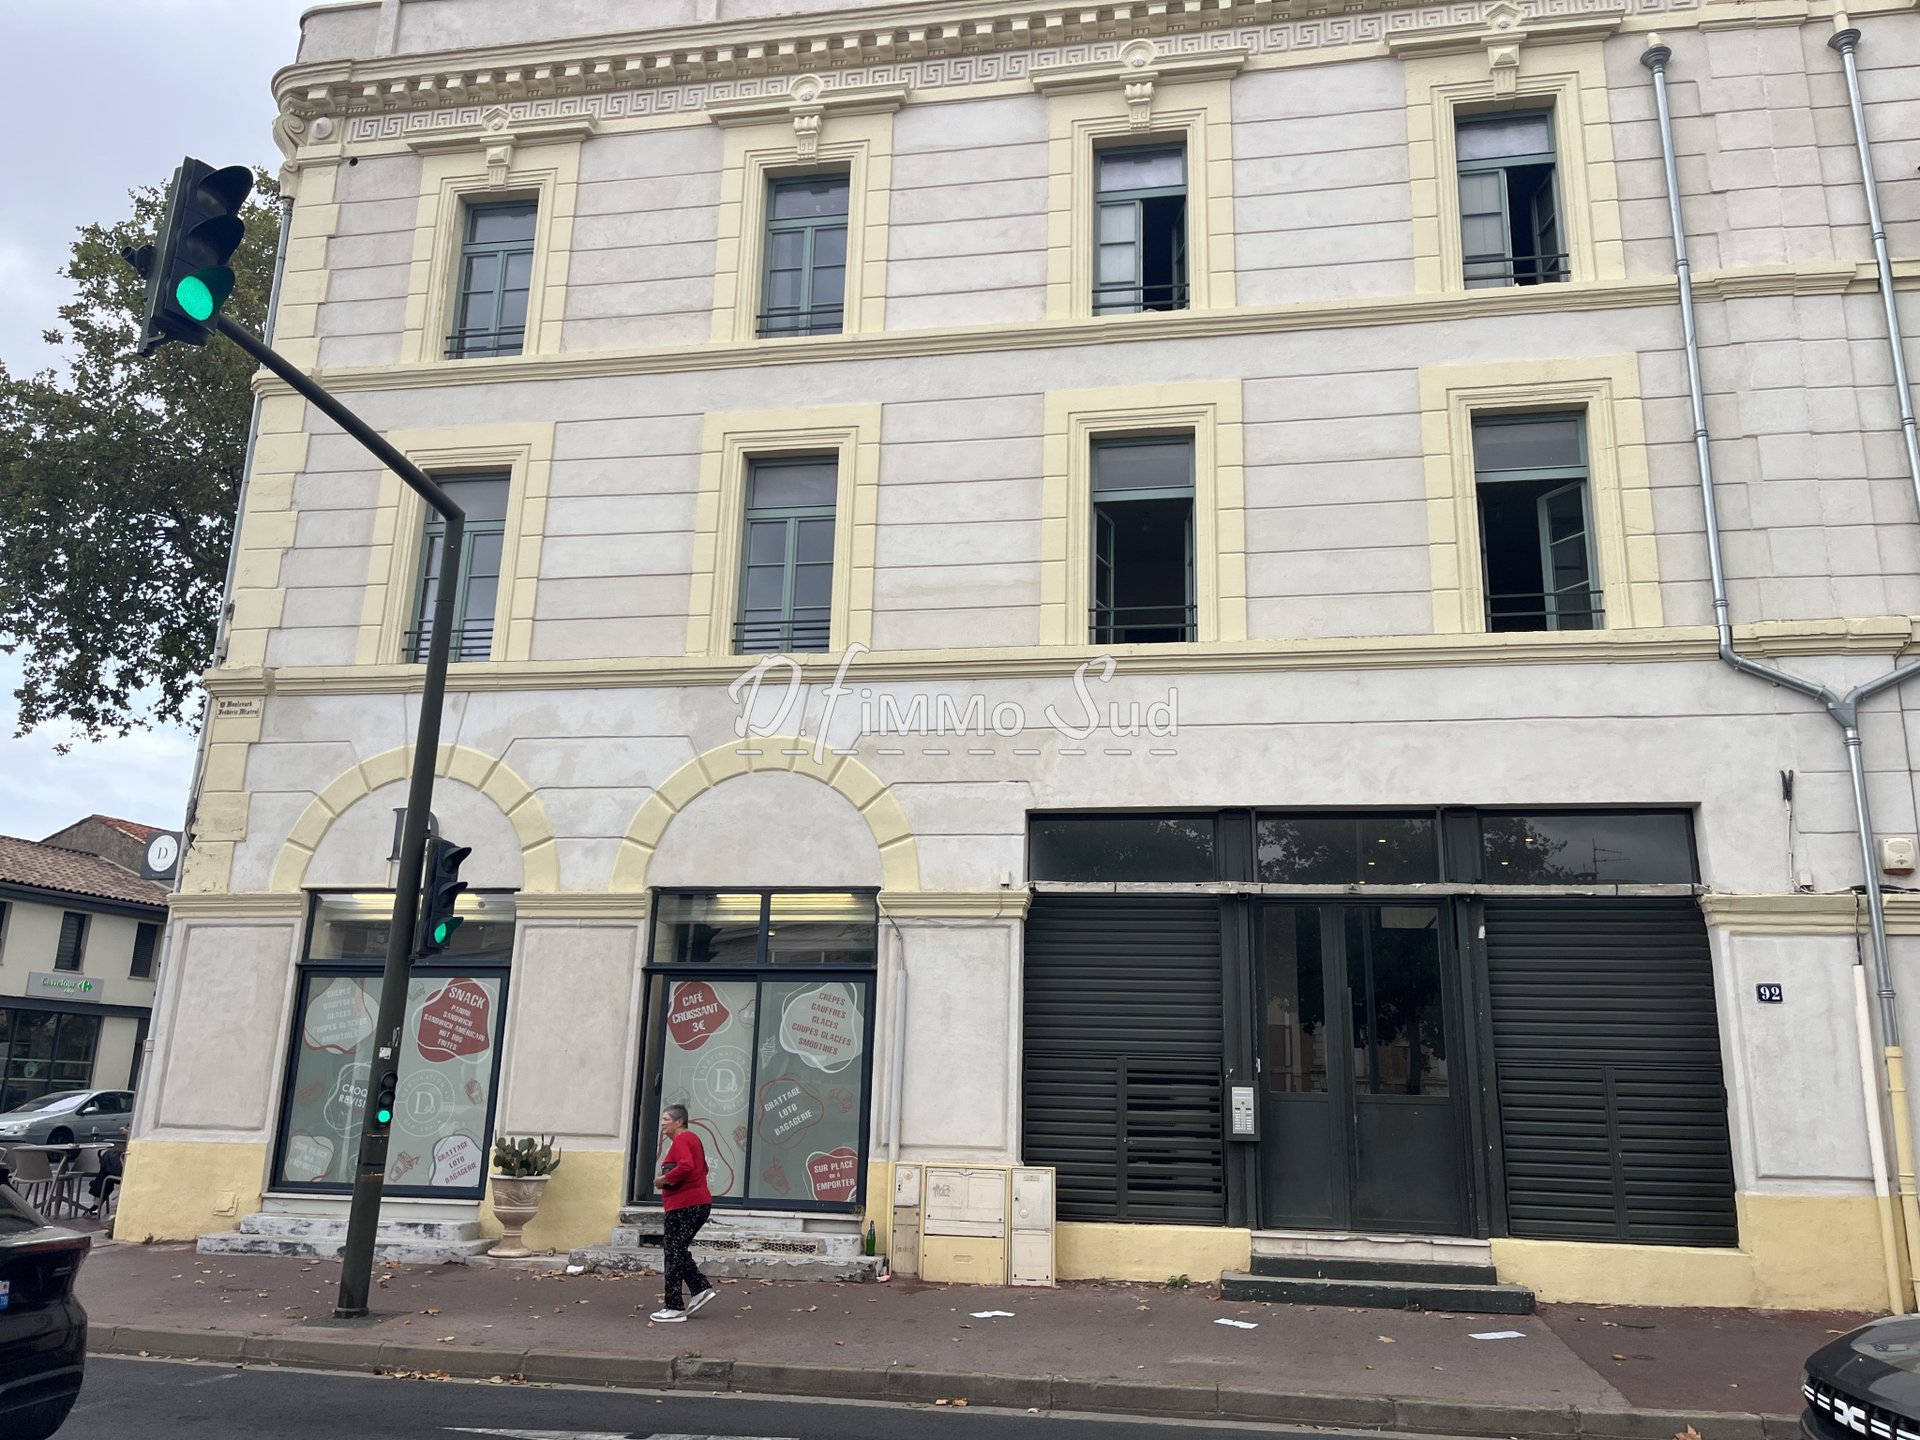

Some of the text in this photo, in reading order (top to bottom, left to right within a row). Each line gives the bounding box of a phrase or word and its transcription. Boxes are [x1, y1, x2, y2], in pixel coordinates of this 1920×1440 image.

[449, 986, 486, 1009] SNACK
[682, 990, 704, 1007] CAFÉ
[1760, 986, 1780, 1000] 92
[672, 1002, 719, 1024] CROISSANT
[692, 1020, 706, 1032] 3€
[792, 1022, 819, 1036] COUPES
[811, 1016, 839, 1030] GLACES
[437, 1038, 458, 1051] FRITES
[798, 1037, 839, 1056] SMOOTHIES
[342, 1083, 368, 1098] CROQ
[338, 1094, 367, 1109] REVISI
[764, 1086, 802, 1112] GRATTAGE
[778, 1103, 798, 1119] LOTO
[774, 1109, 813, 1136] BAGAGERIE
[437, 1140, 469, 1162] GRATTAGE
[448, 1155, 465, 1169] LOTO
[814, 1160, 854, 1174] SUR PLACE
[444, 1161, 478, 1184] BAGAGERIE
[816, 1178, 856, 1191] EMPORTER
